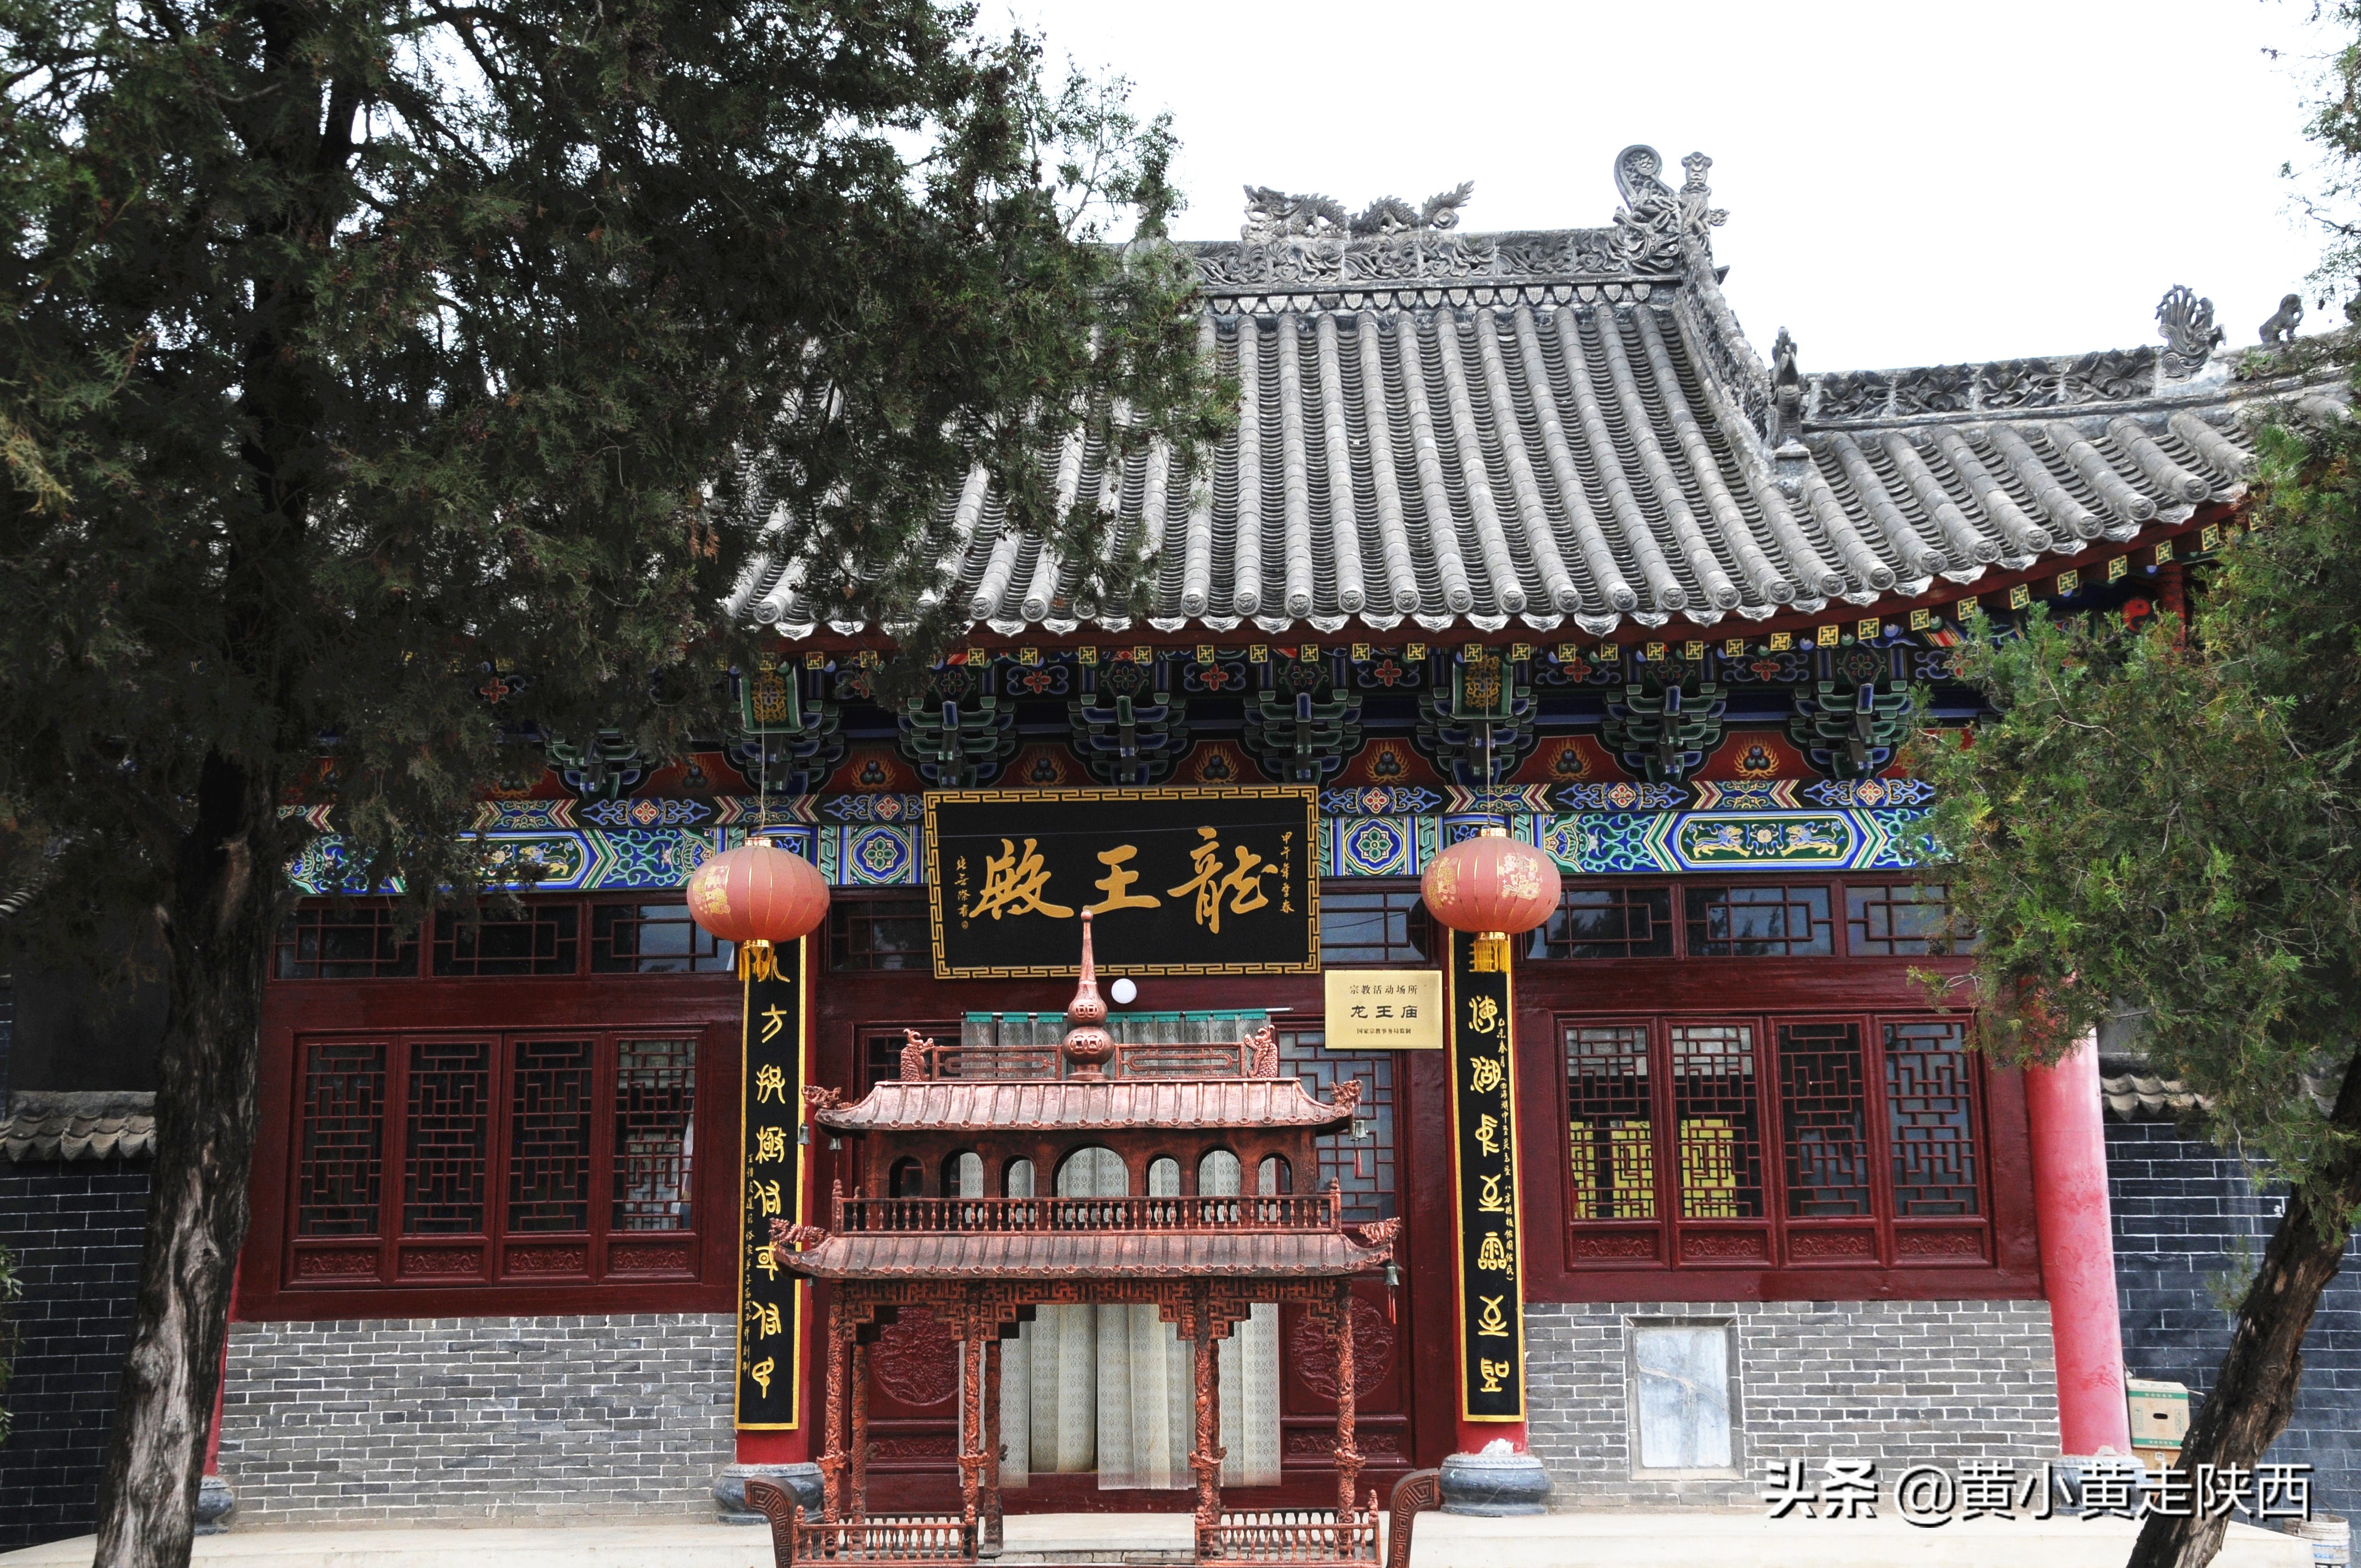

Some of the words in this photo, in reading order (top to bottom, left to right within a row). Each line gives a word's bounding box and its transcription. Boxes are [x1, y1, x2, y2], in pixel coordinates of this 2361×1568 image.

[1350, 984, 1418, 995] 宗教活动场所
[1351, 1005, 1418, 1019] 龙王庙
